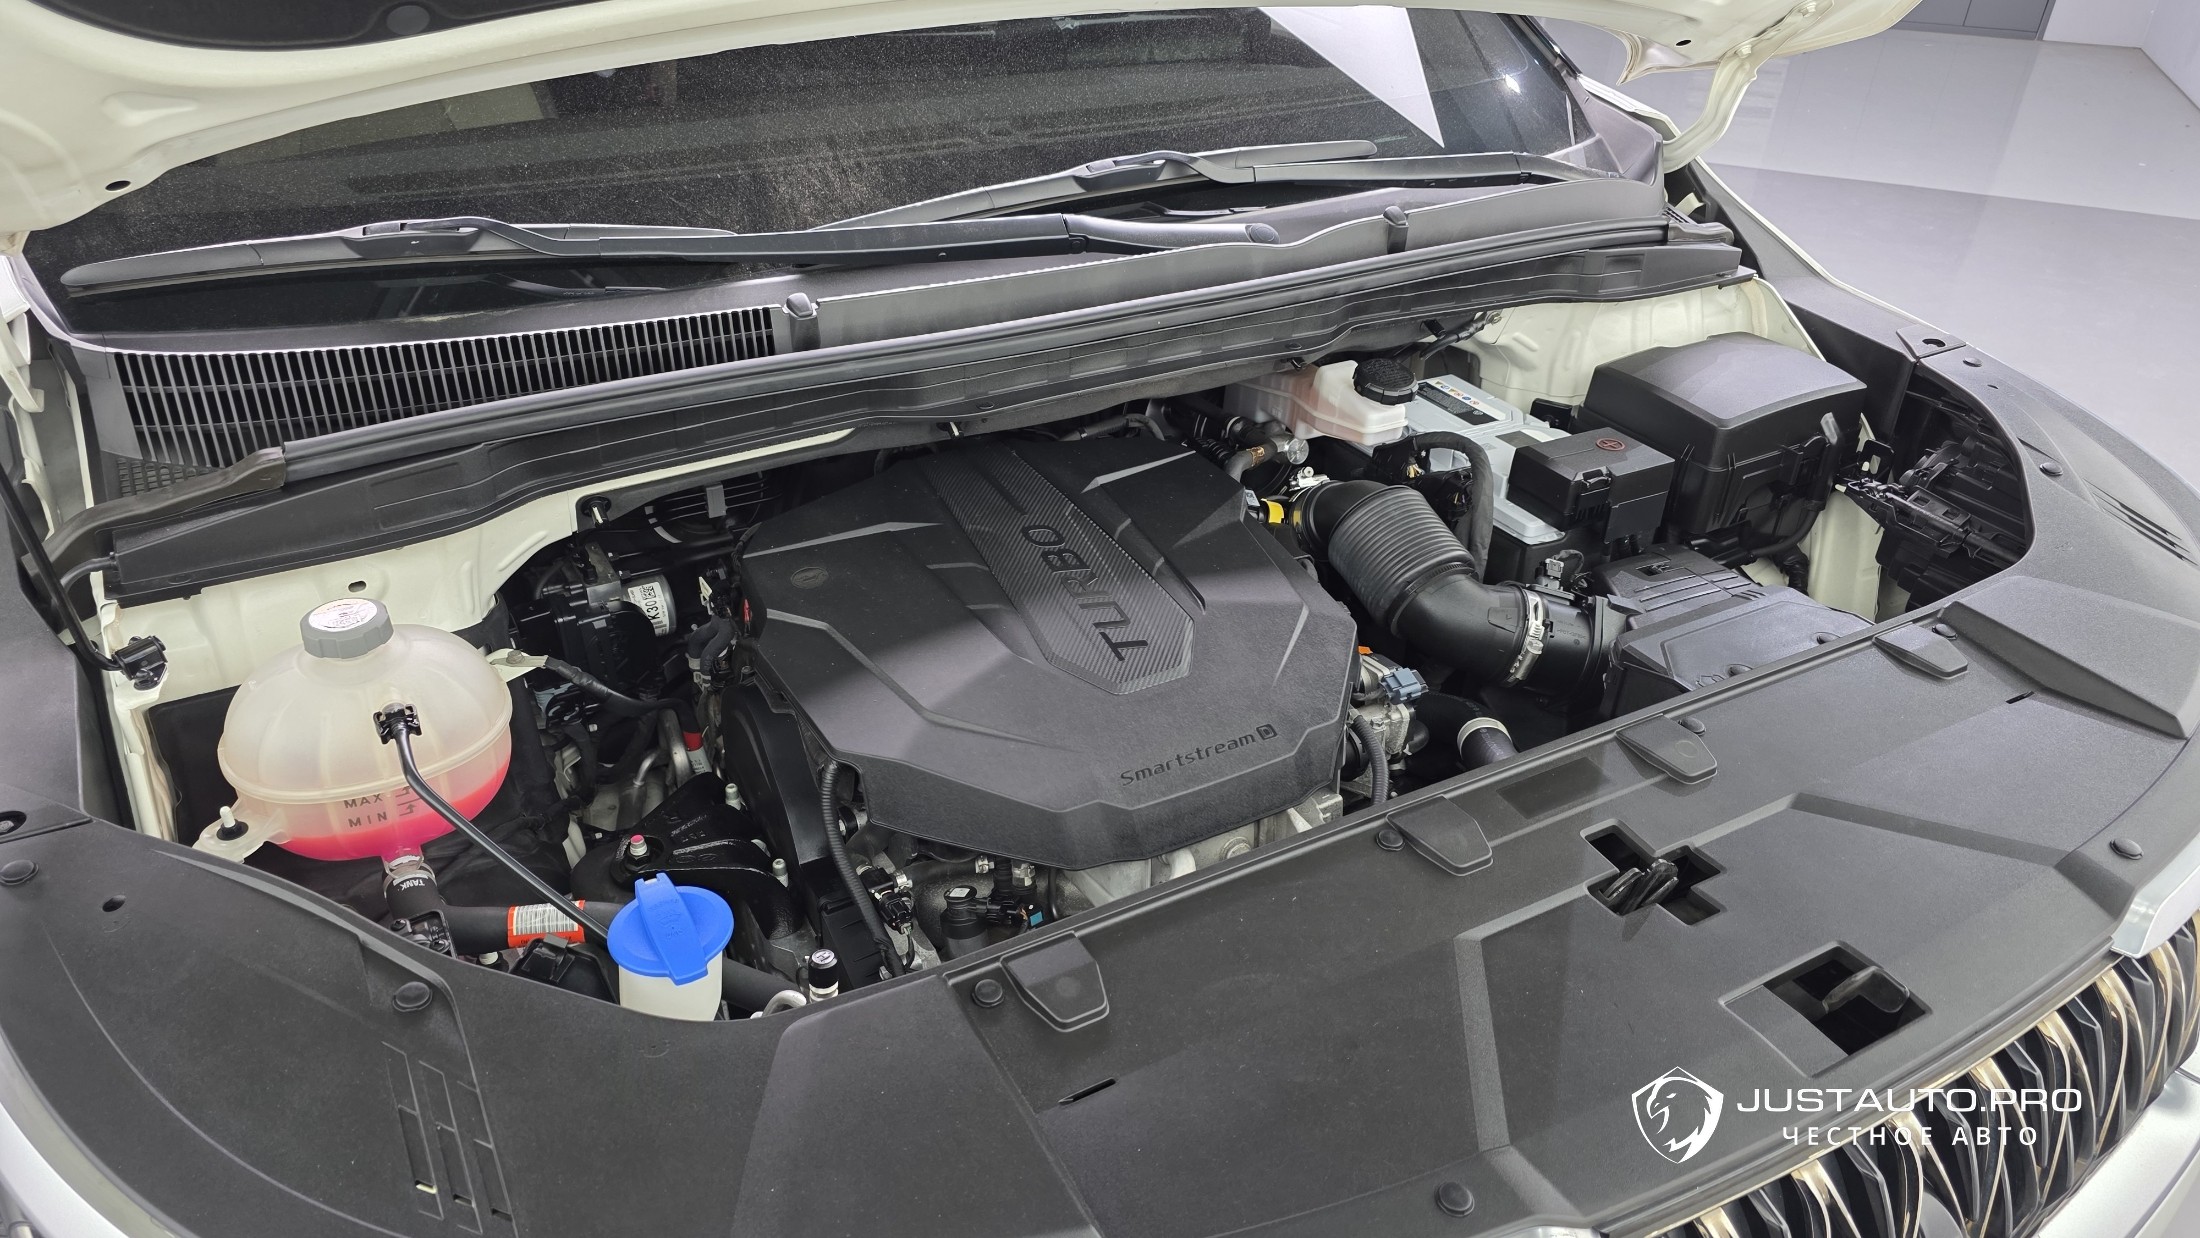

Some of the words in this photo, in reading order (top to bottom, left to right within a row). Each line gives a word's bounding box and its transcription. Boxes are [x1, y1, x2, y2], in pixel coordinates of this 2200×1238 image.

[1021, 524, 1149, 662] TURBO
[644, 600, 661, 621] K30
[1120, 733, 1256, 786] Smartstream
[343, 793, 383, 809] MAX
[348, 811, 388, 828] MIN
[400, 879, 426, 891] TANK
